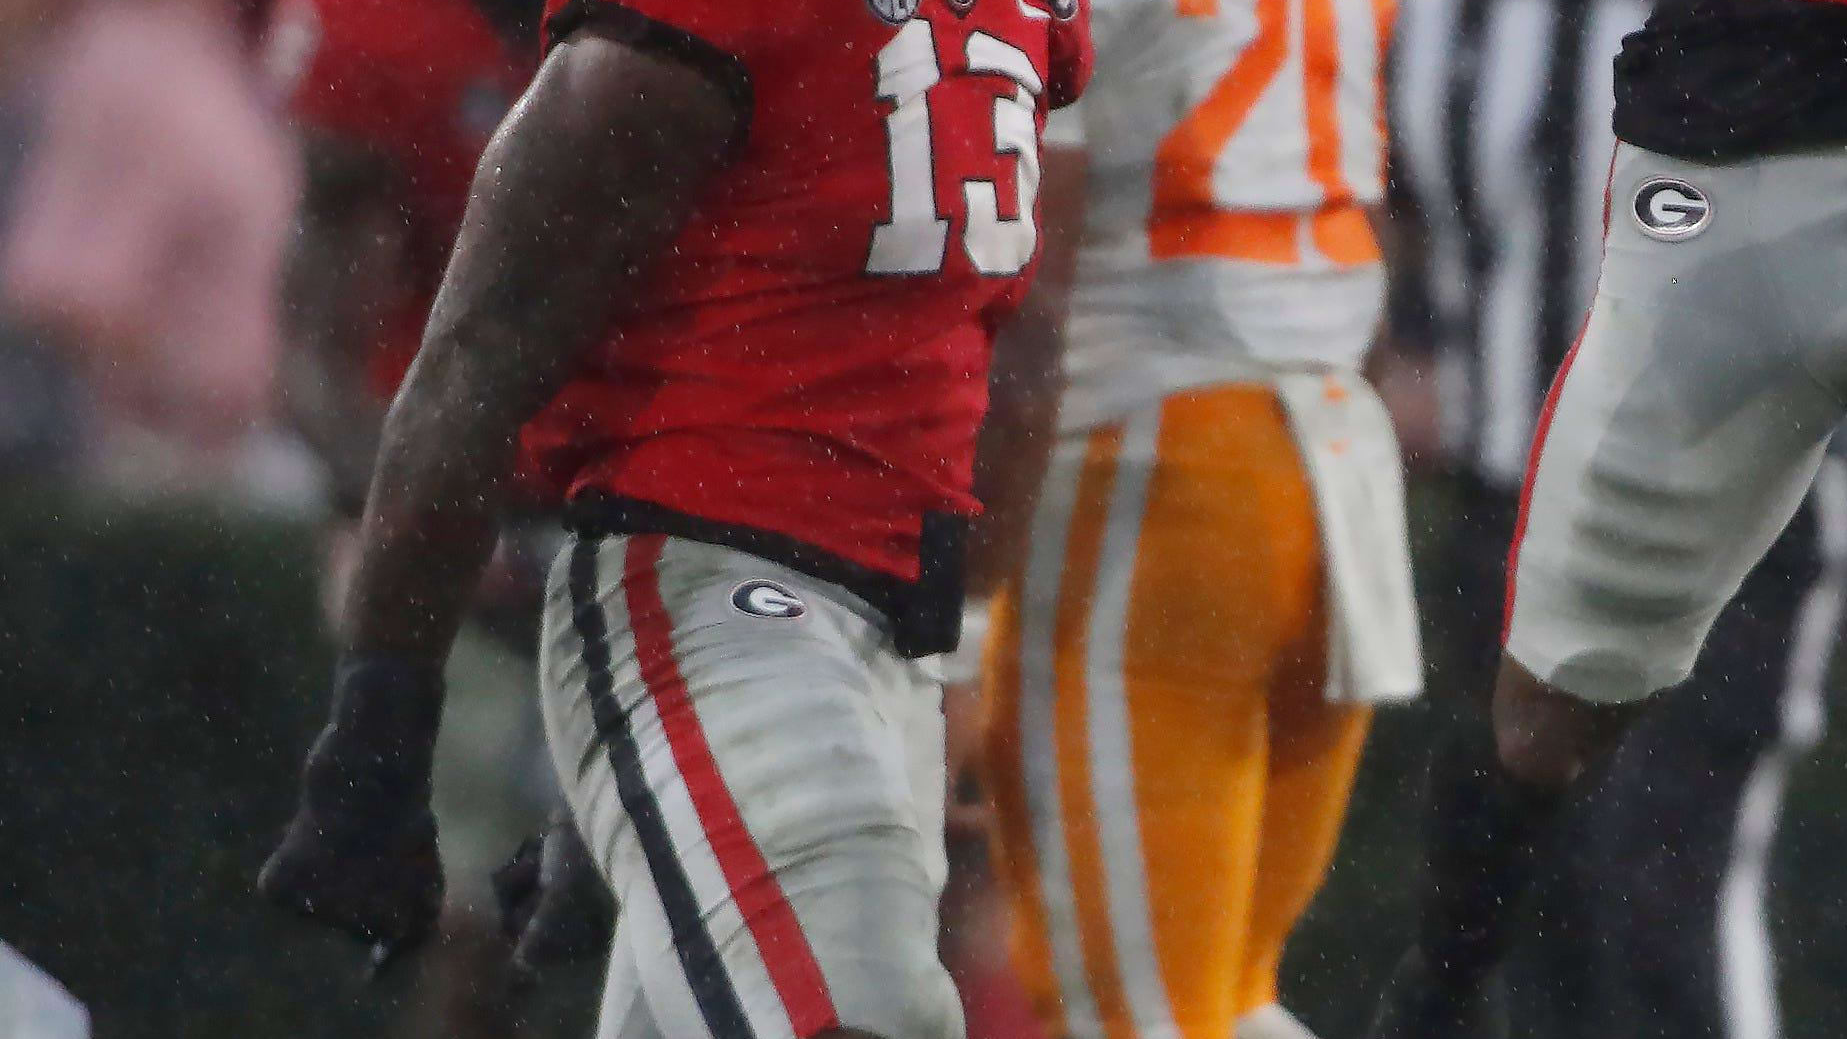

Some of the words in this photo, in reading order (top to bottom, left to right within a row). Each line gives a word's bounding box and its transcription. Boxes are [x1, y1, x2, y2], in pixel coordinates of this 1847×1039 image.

[865, 17, 1045, 276] 13
[1640, 182, 1709, 229] G
[740, 582, 804, 615] G
